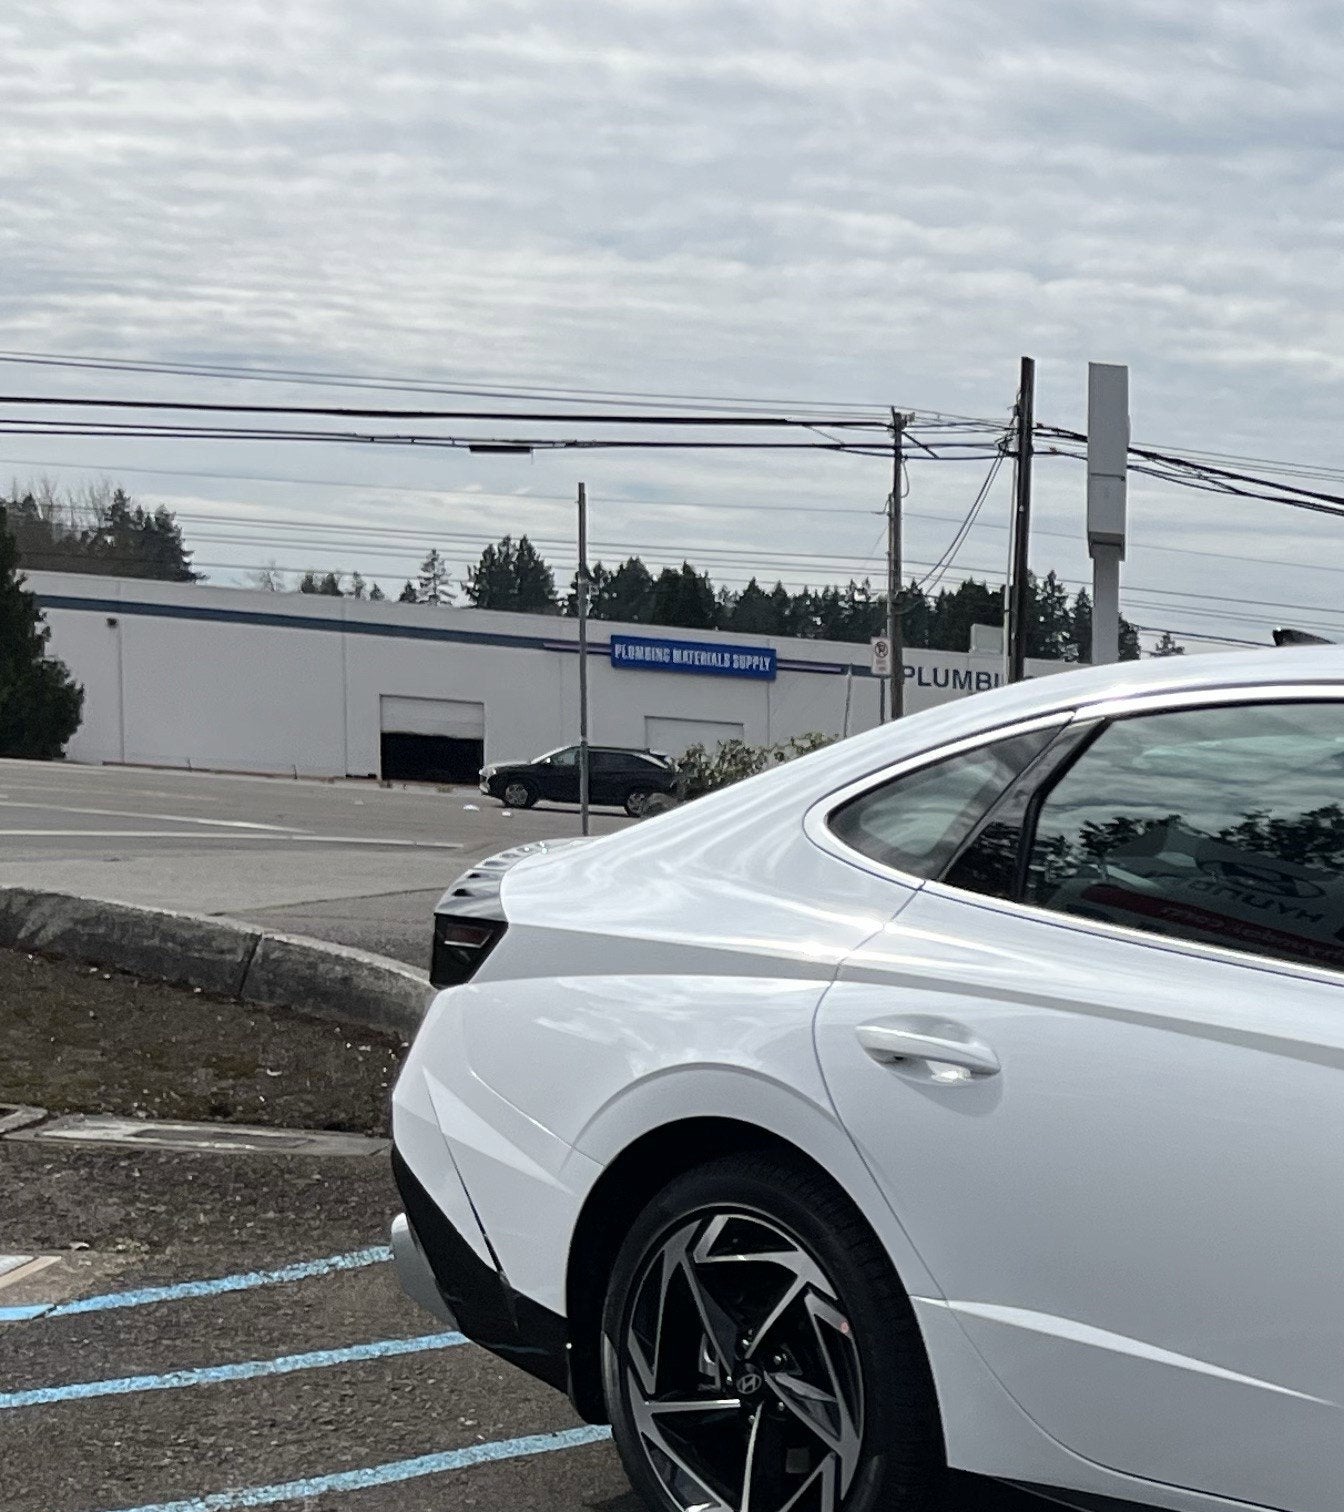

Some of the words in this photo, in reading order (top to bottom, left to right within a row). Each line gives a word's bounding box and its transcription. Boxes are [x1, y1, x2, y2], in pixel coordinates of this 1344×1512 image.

[614, 643, 671, 663] PLUMBING
[672, 648, 731, 668] MATERIALS
[732, 653, 771, 672] SUPPLY
[903, 665, 1000, 692] PLUMBI
